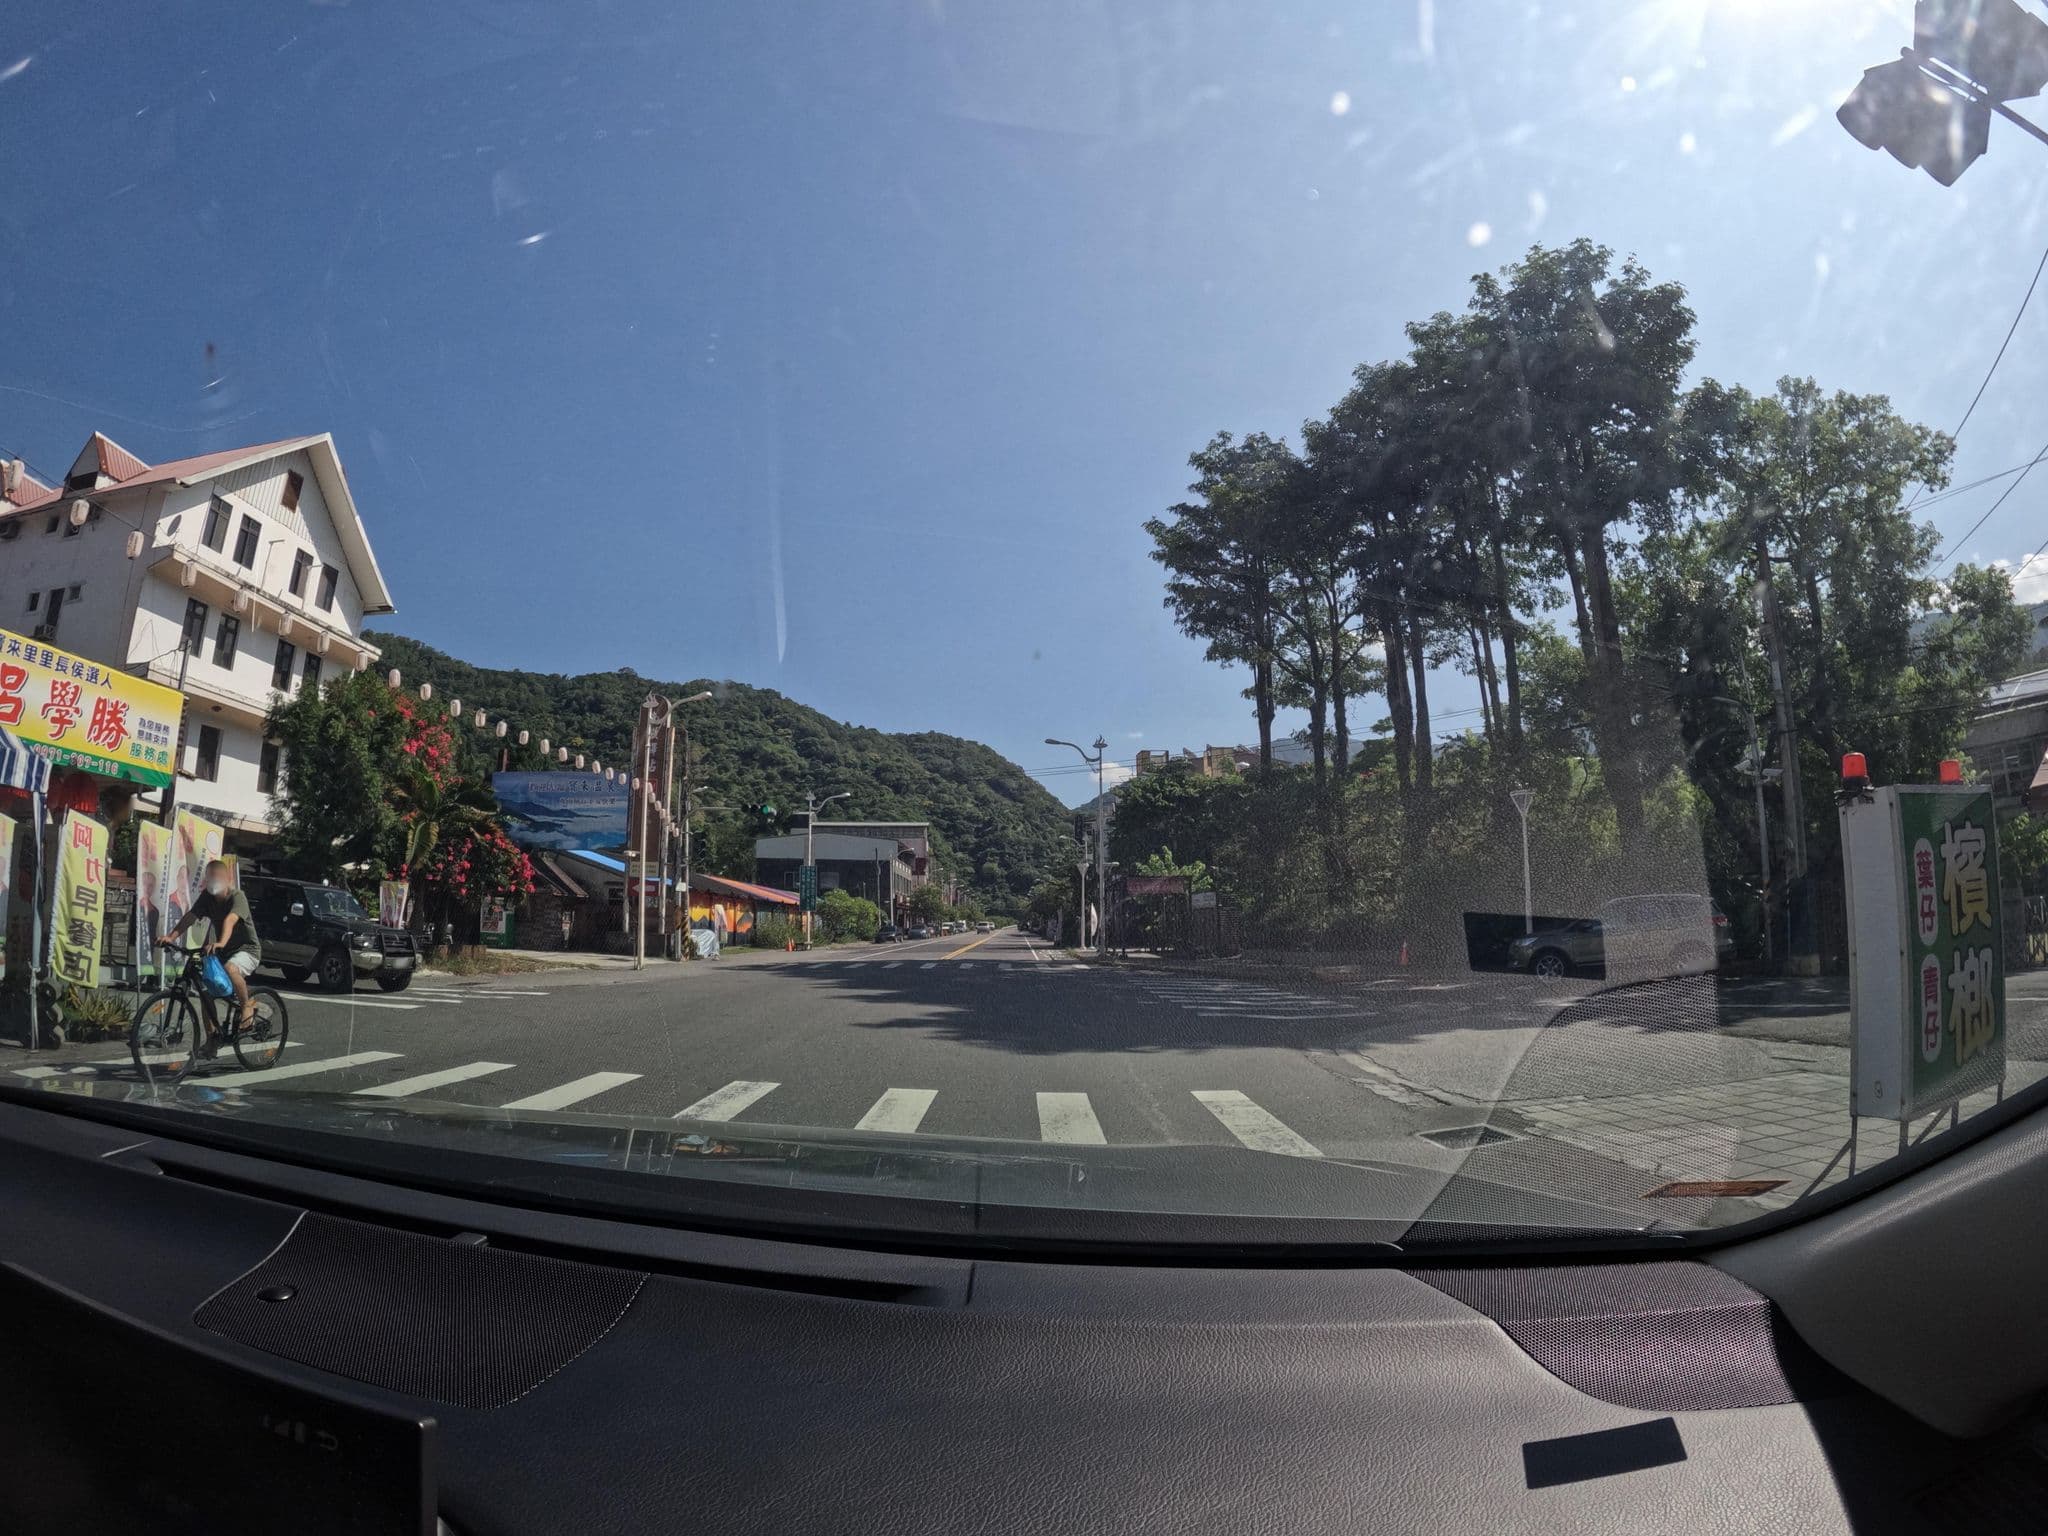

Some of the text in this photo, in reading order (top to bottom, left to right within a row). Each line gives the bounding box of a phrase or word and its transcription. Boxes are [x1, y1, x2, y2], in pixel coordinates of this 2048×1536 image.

[0, 663, 129, 752] 呂學勝
[130, 743, 168, 766] 服務處
[1916, 849, 1935, 933] 葉仔
[1940, 820, 1994, 1065] 檳榔
[1923, 965, 1940, 1051] 青仔
